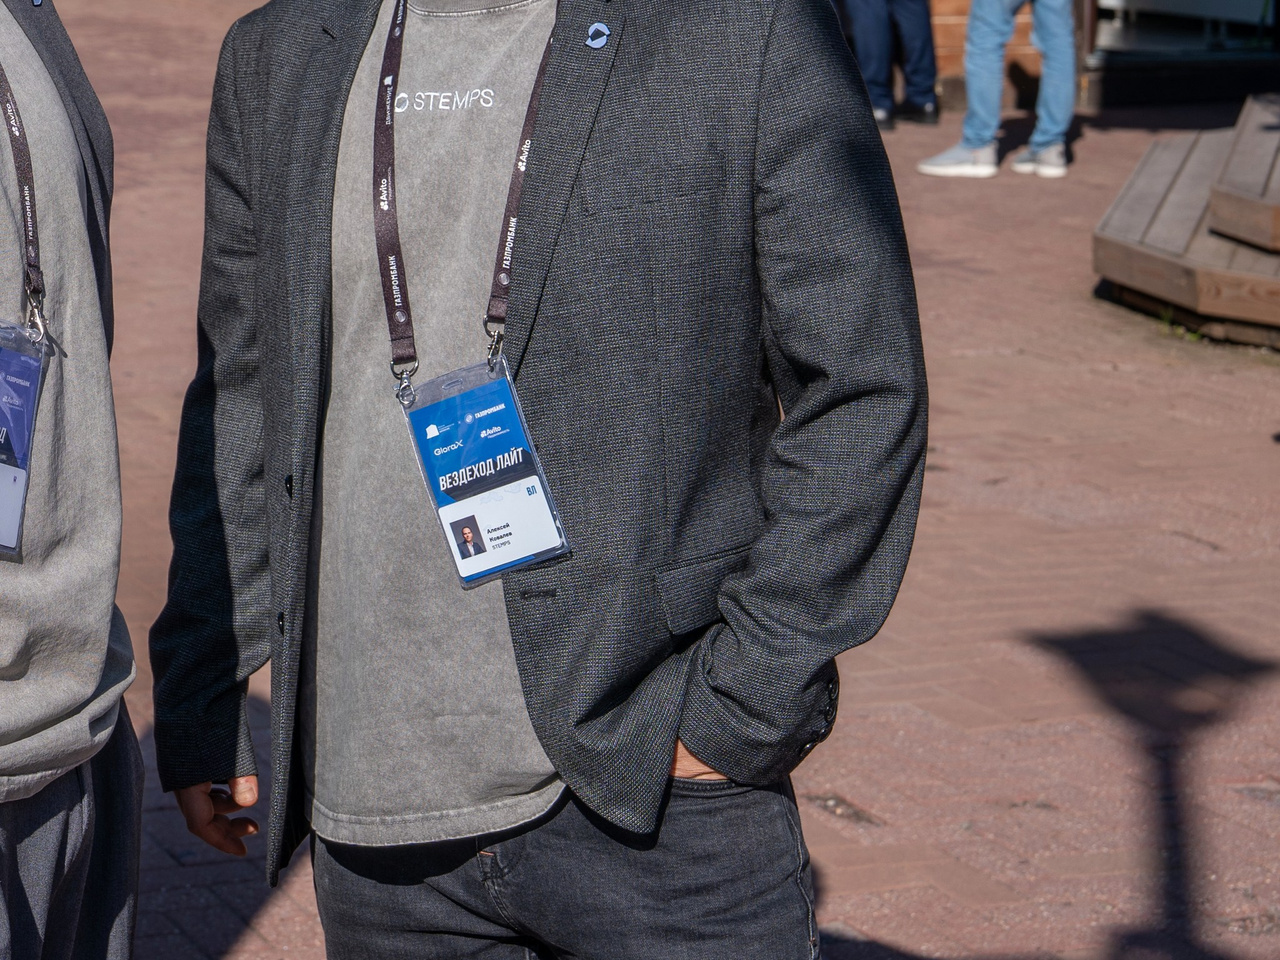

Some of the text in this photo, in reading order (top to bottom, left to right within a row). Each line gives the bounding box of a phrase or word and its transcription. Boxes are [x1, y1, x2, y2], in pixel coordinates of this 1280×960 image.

[413, 88, 495, 112] STEMPS
[6, 103, 17, 126] Avito
[520, 139, 531, 162] Avito
[380, 178, 388, 201] Avito
[23, 185, 34, 240] ГАЗПРОМБАНК
[503, 216, 518, 269] ГАЗПРОМБАНК
[388, 255, 403, 307] ГАЗПРОМБАНК
[485, 426, 502, 436] Avito
[433, 439, 464, 456] GloraX
[438, 447, 523, 491] ВЕЗДЕХОД ЛАЙТ
[526, 485, 537, 496] ВЛ
[487, 522, 510, 534] Алексей
